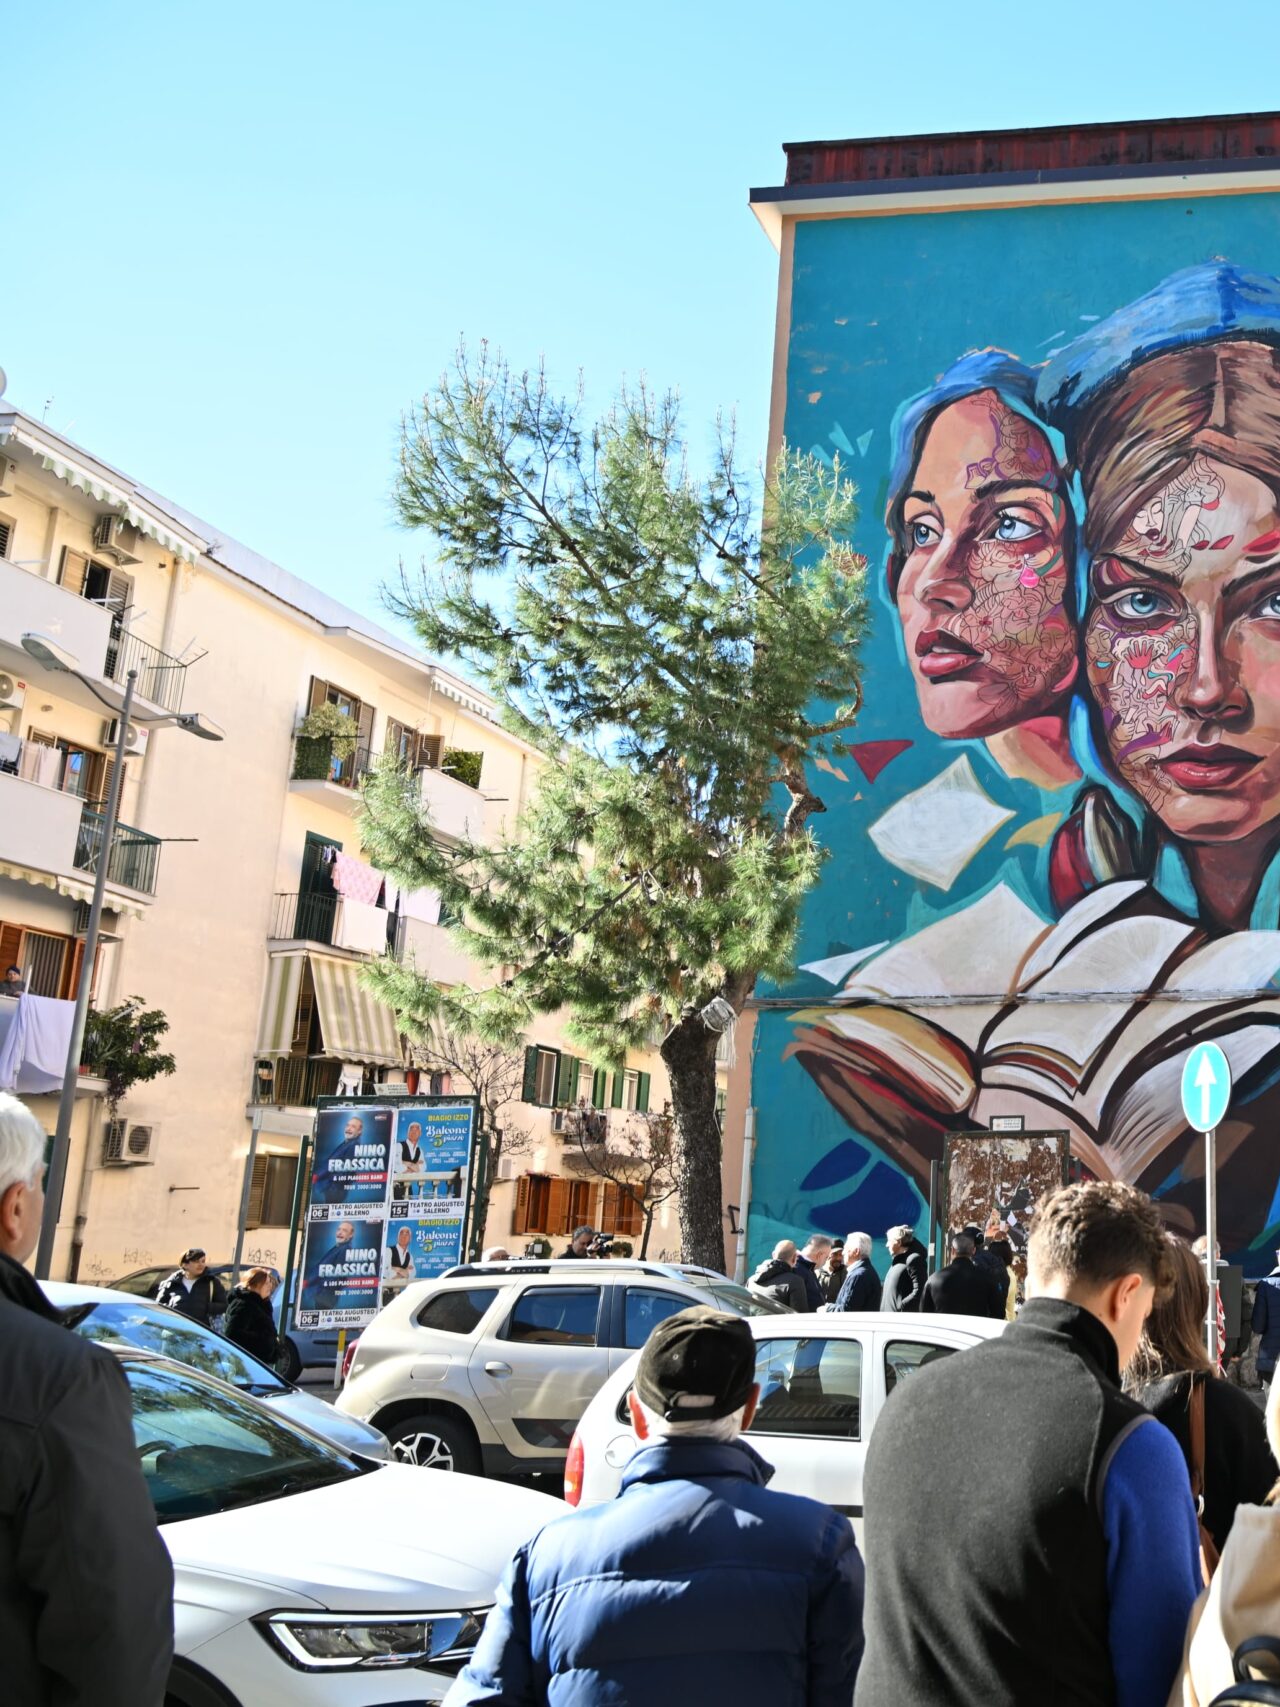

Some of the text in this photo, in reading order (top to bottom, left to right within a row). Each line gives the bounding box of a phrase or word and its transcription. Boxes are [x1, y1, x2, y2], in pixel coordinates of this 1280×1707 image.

[426, 1125, 468, 1137] Balcone
[433, 1134, 444, 1147] 5
[354, 1144, 386, 1158] NINO
[328, 1158, 385, 1172] FRASSICA
[312, 1209, 323, 1218] 06
[416, 1230, 458, 1242] Balcone
[424, 1240, 433, 1252] 5
[345, 1248, 377, 1262] NINO
[318, 1262, 376, 1278] FRASSICA
[302, 1316, 312, 1324] 06
